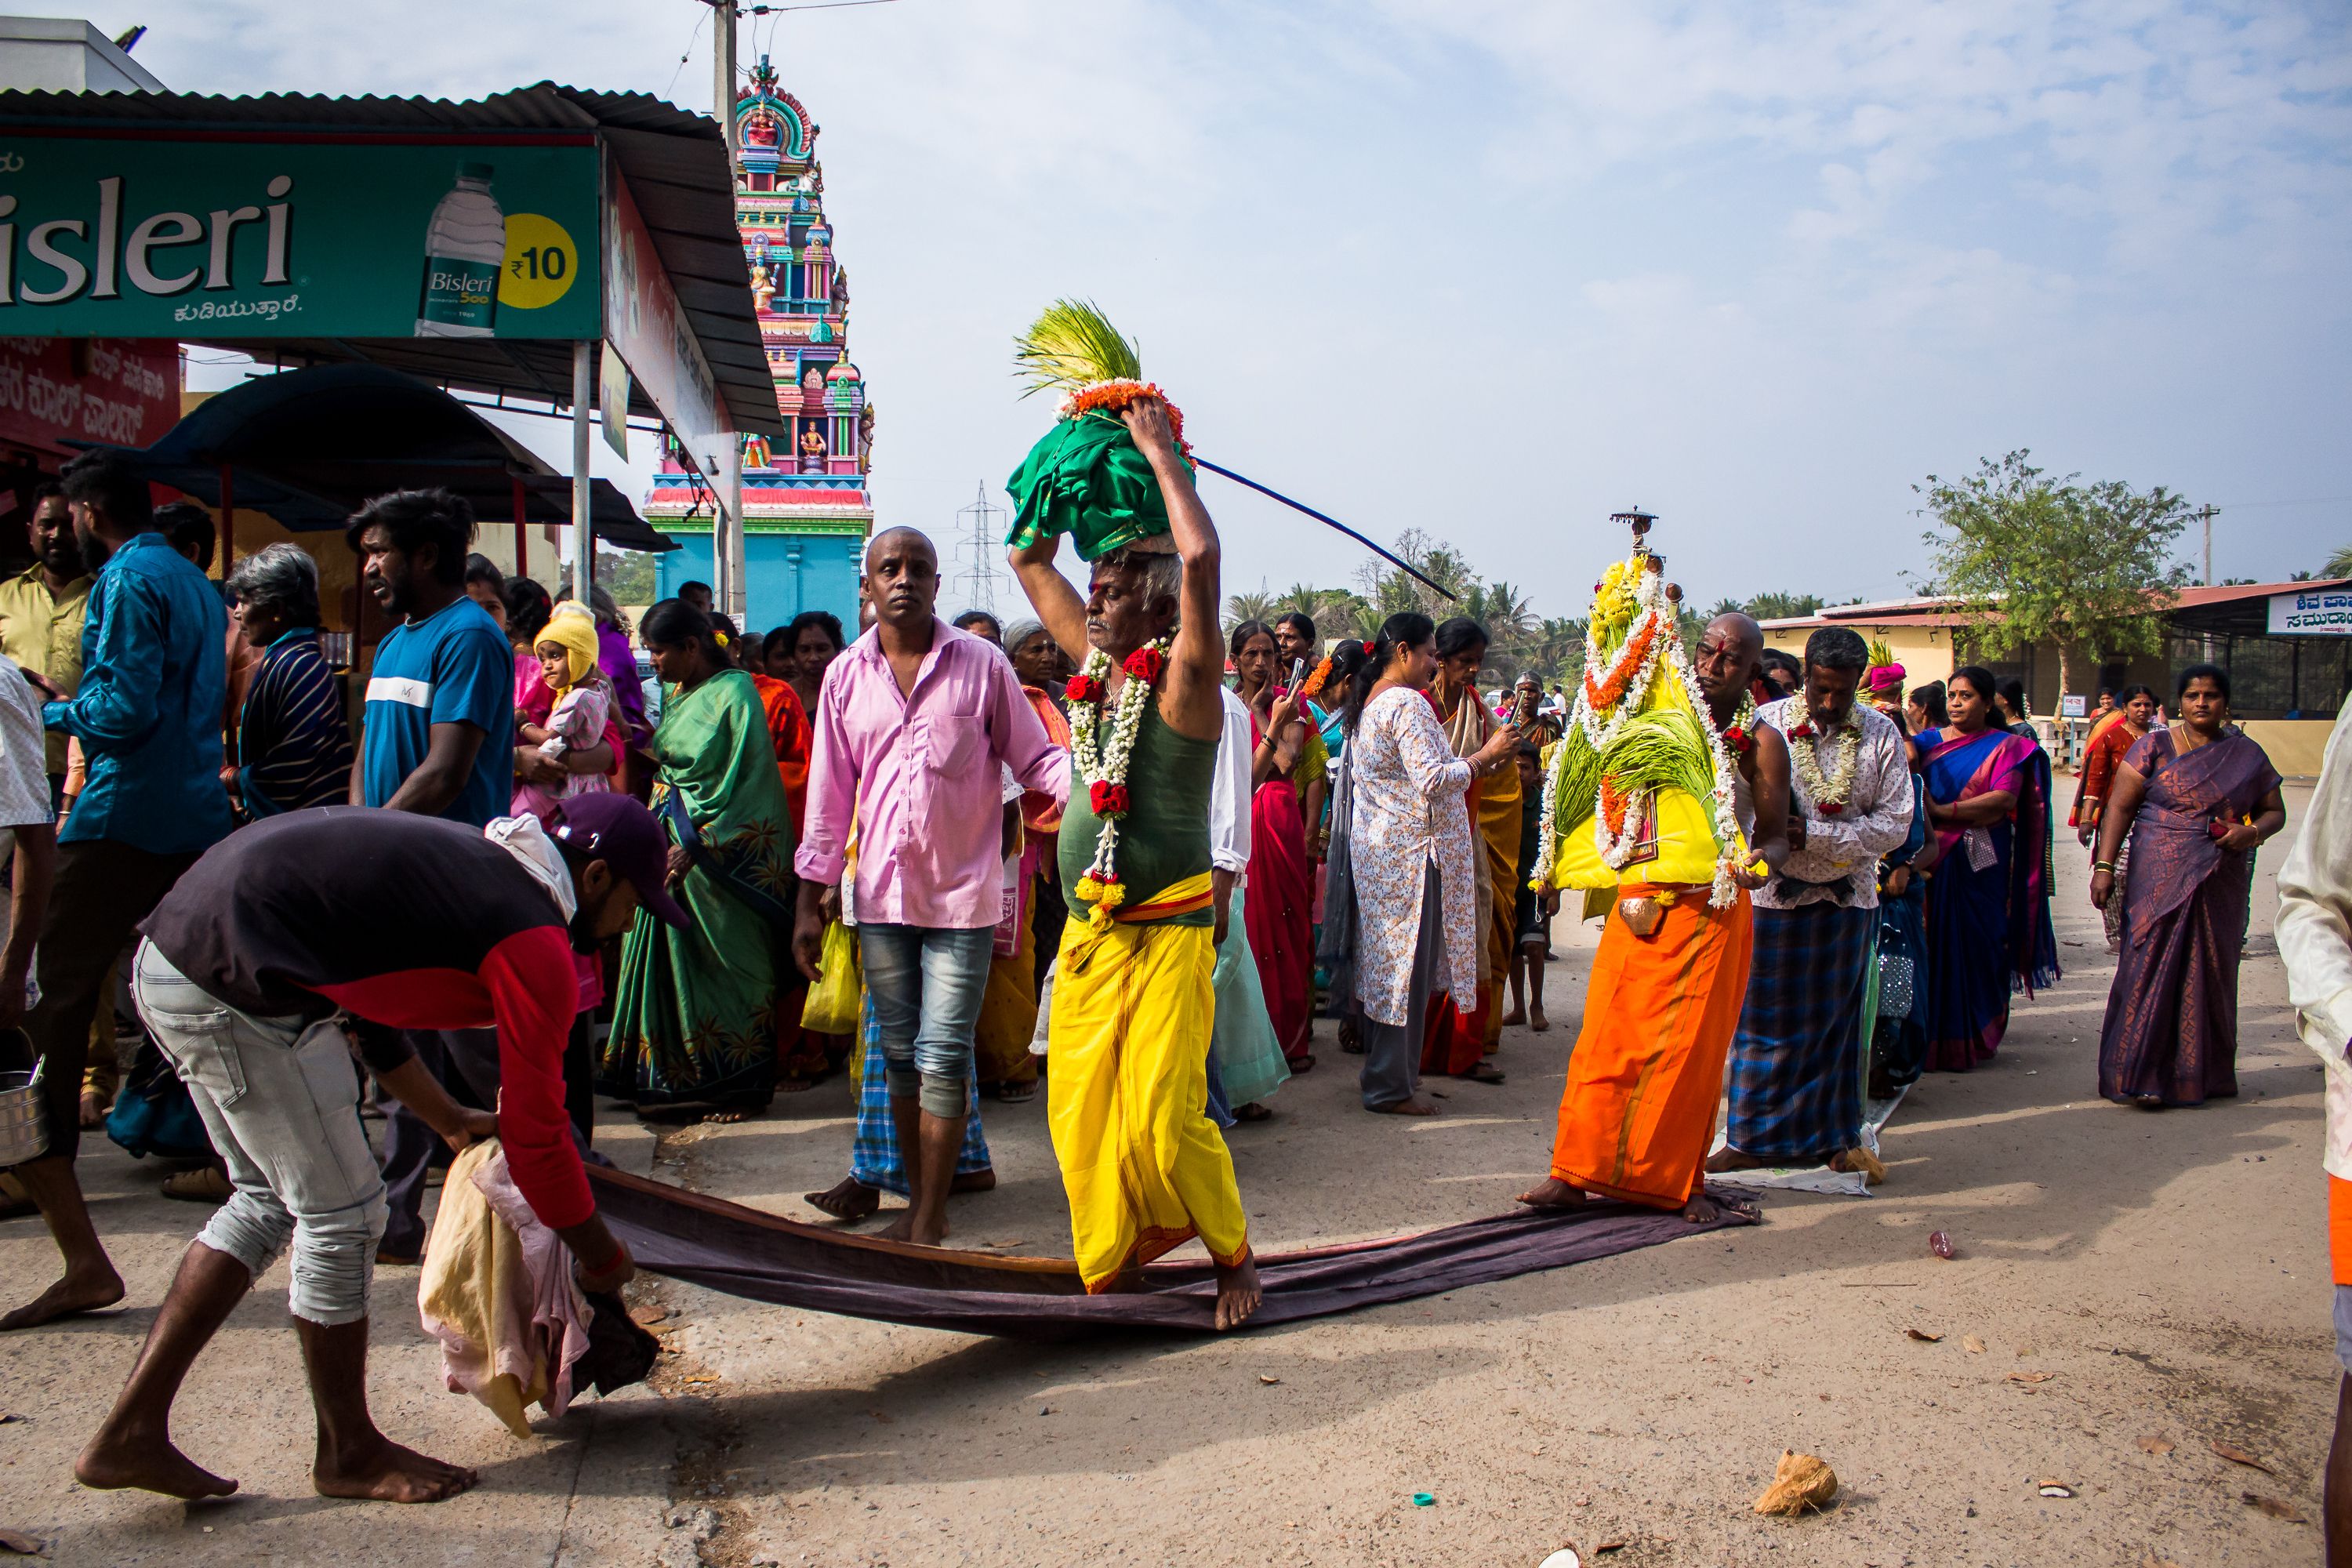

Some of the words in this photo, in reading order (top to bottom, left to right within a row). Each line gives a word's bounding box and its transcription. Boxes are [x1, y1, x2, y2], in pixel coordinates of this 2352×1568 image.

[510, 247, 565, 280] ₹10
[430, 272, 493, 292] Bisleri
[2296, 594, 2320, 610] ಶಿವ
